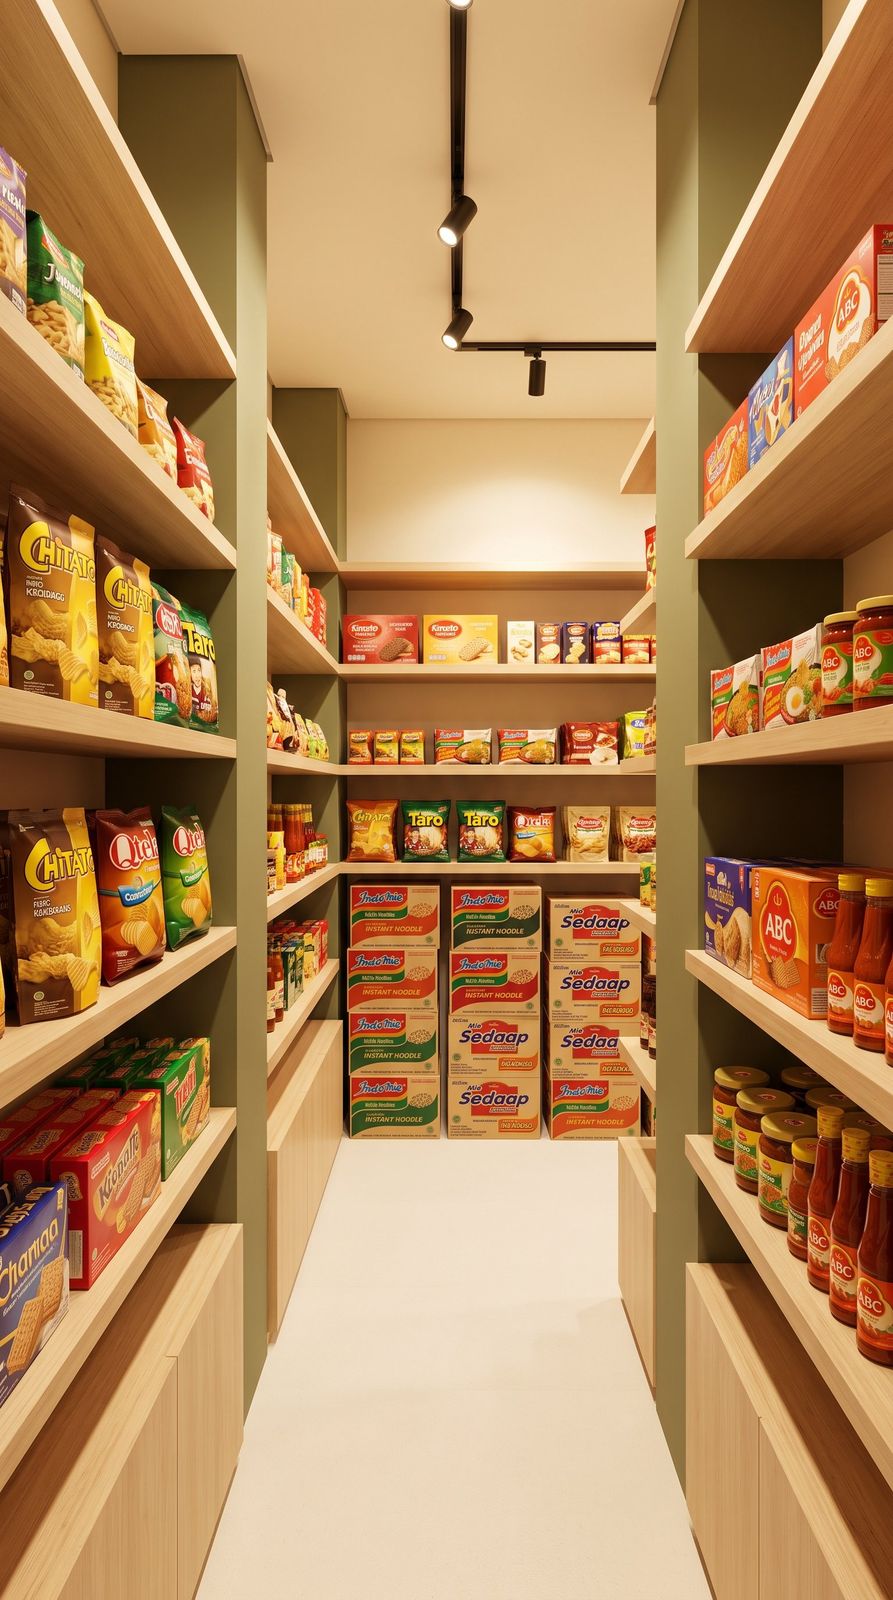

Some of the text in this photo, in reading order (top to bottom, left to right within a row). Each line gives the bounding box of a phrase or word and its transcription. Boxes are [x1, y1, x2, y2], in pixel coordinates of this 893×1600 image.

[838, 290, 858, 326] ABC
[181, 620, 216, 662] Taro
[855, 646, 872, 659] ABC
[823, 657, 839, 669] ABC
[408, 812, 444, 827] Taro
[463, 812, 499, 827] Taro
[560, 915, 630, 932] Sedaap
[765, 913, 792, 945] ABC
[560, 976, 630, 993] Sedaap
[828, 984, 845, 995] ABC
[855, 995, 874, 1008] ABC
[459, 1029, 528, 1046] Sedaap
[560, 1034, 619, 1048] Sedaa
[459, 1091, 529, 1108] Sedaap
[808, 1232, 827, 1248] ABC
[831, 1258, 852, 1278] ABC
[858, 1291, 882, 1314] ABC
